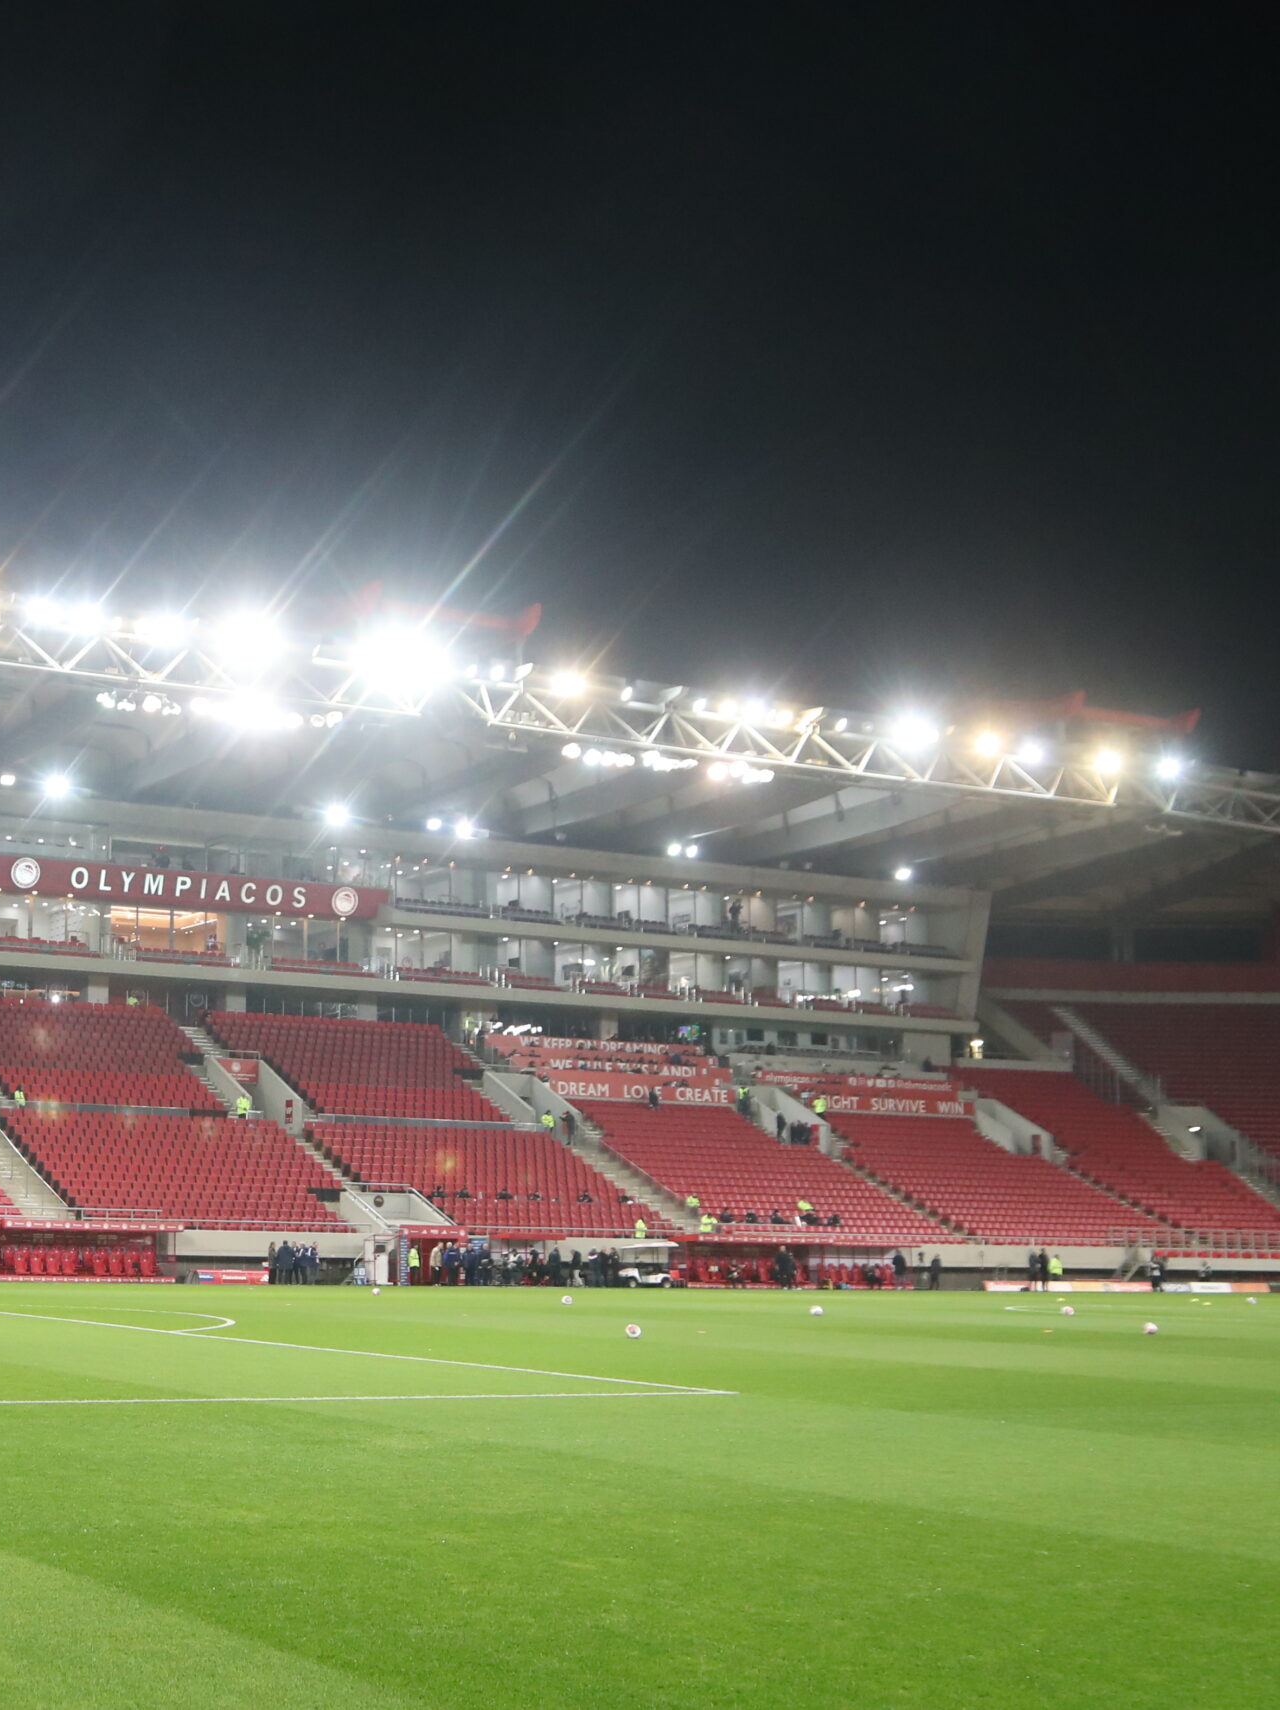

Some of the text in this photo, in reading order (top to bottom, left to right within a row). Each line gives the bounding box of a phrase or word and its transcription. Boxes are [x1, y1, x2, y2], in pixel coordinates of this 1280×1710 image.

[70, 866, 307, 909] OLYMPIACOS
[520, 1036, 539, 1047] WE
[543, 1037, 573, 1049] KEEP
[575, 1039, 597, 1050] ON
[550, 1058, 572, 1070] WE
[624, 1084, 662, 1100] LOVE
[676, 1087, 728, 1103] CREATE
[818, 1094, 964, 1115] IGHT SURVIVE WIN
